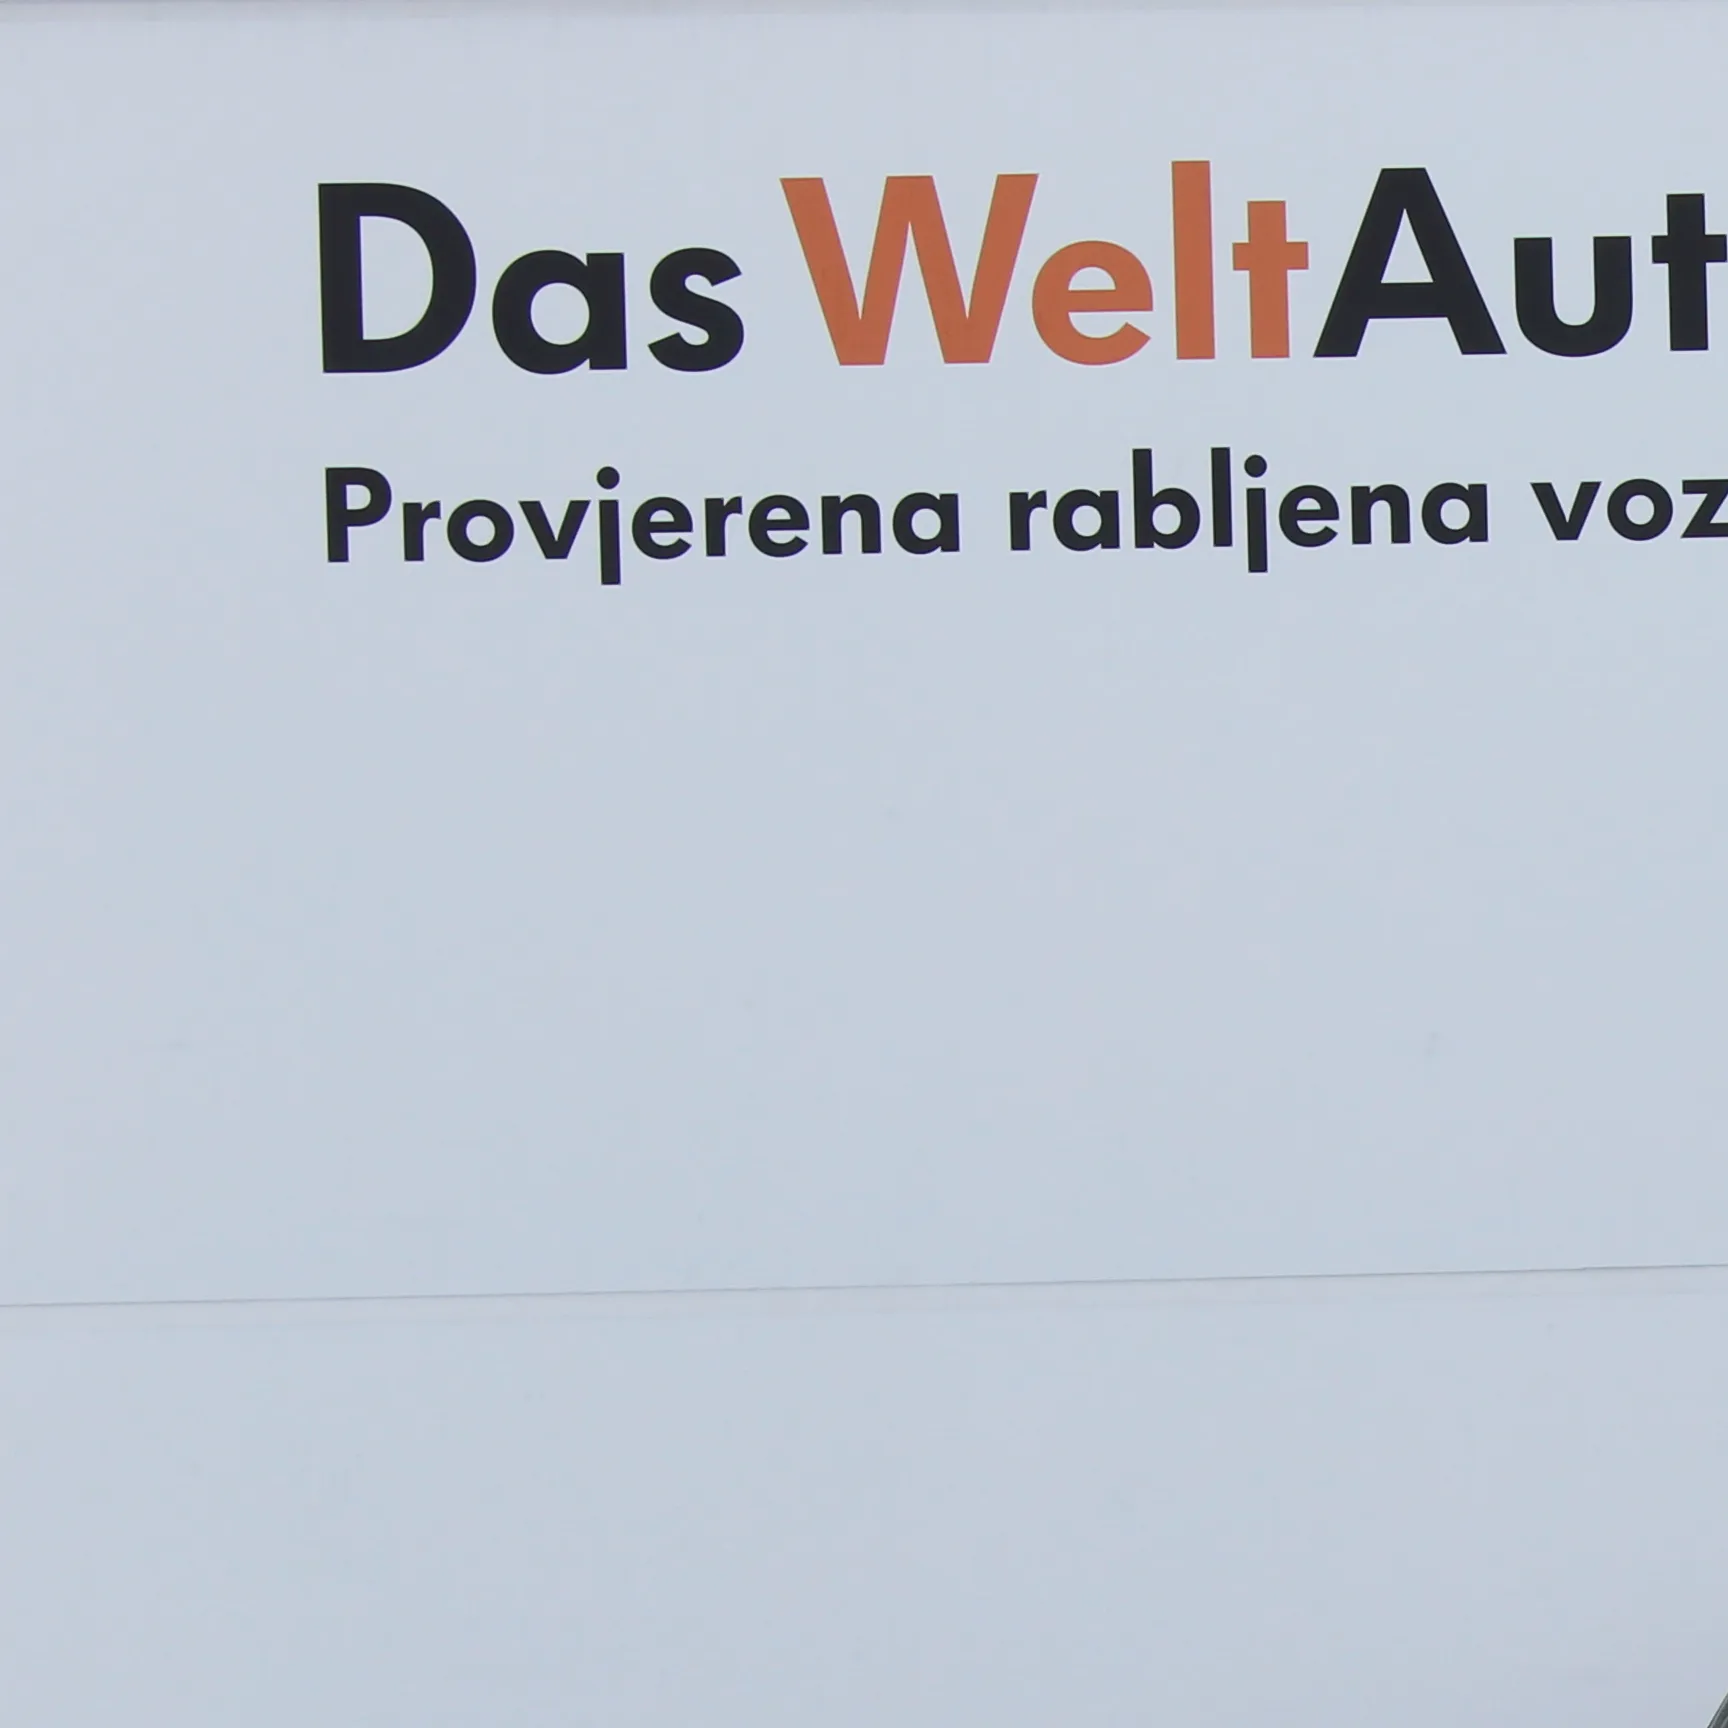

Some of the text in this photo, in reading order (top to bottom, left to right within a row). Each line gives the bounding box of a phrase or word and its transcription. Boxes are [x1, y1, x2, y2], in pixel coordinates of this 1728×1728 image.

[318, 183, 745, 375] Das
[324, 466, 960, 586] Provjerena
[1008, 446, 1489, 574] rabljena
